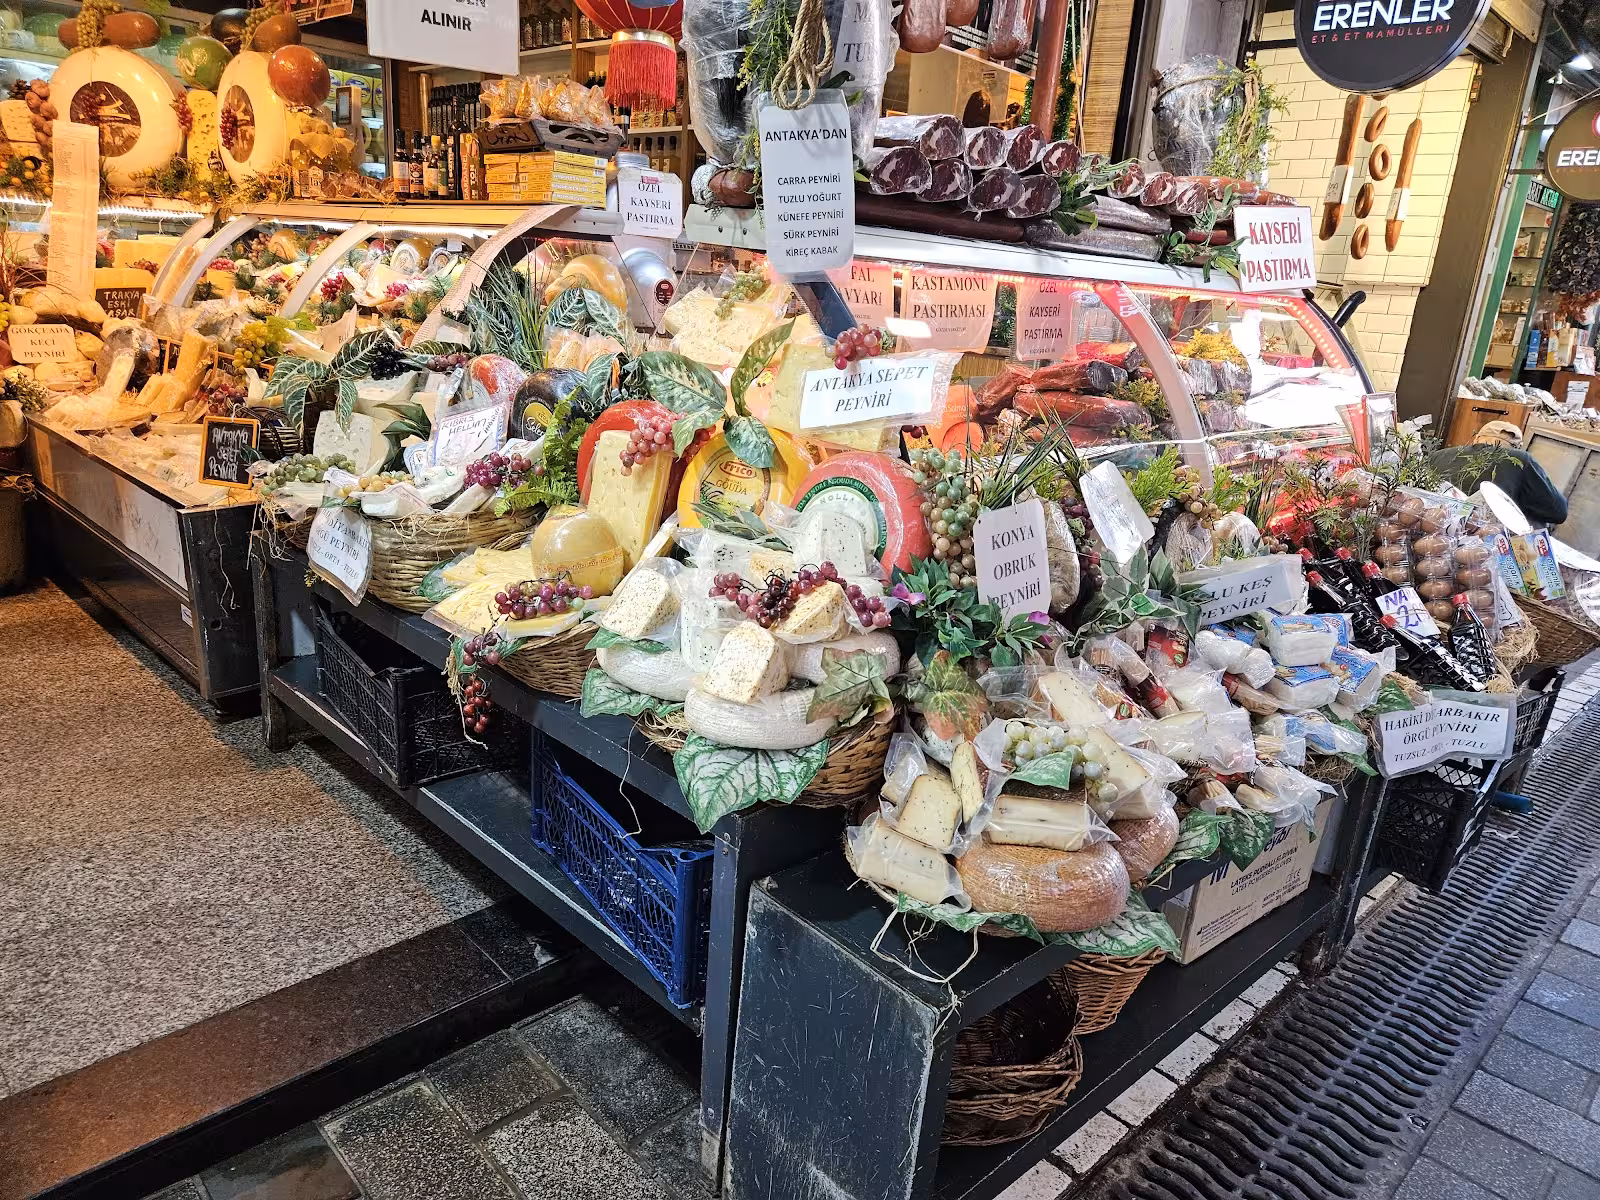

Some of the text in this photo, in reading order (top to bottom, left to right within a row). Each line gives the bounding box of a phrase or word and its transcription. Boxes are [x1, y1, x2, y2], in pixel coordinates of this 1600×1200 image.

[420, 9, 471, 31] ALINIR
[1313, 0, 1453, 31] ERENLER
[1311, 34, 1327, 44] ET
[1331, 33, 1338, 42] &
[1344, 32, 1361, 41] ET
[1557, 149, 1600, 167] ERE
[777, 173, 841, 186] CARRA PEYNİRİ
[630, 197, 672, 210] KAYSERİ
[778, 192, 842, 204] TUZLU YOĞURT
[627, 212, 675, 226] PASTIRMA
[777, 209, 844, 223] KÜNEFE PEYNİRİ
[783, 227, 839, 240] SÜRK PEYNİRİ
[1249, 217, 1302, 245] KAYSERİ
[785, 245, 839, 258] KİREÇ KABAK
[850, 266, 875, 283] FAL
[1246, 258, 1311, 283] PASTIRMA
[912, 275, 988, 292] KASTAMONU
[104, 290, 140, 300] TRAKYA
[844, 289, 883, 306] VYARI
[913, 304, 986, 319] PASTIRMASI
[1029, 305, 1060, 318] KAYSERİ
[11, 326, 70, 335] GÖKÇEADA
[1024, 328, 1063, 341] PASTIRMA
[24, 350, 66, 358] PEYNİRİ
[810, 366, 929, 392] ANTAKYA SEPET
[835, 389, 893, 413] PEYNİRİ
[715, 480, 747, 496] GOUDA
[991, 525, 1035, 551] KONYA
[330, 536, 360, 561] PEYNİRİ
[993, 552, 1036, 581] OBRUK
[1209, 575, 1273, 601] LU KEŞ
[1385, 707, 1501, 731] HAKİKİ DARBAKIR
[1403, 727, 1430, 745] ÖRGÜ
[1451, 738, 1488, 750] TUZLU
